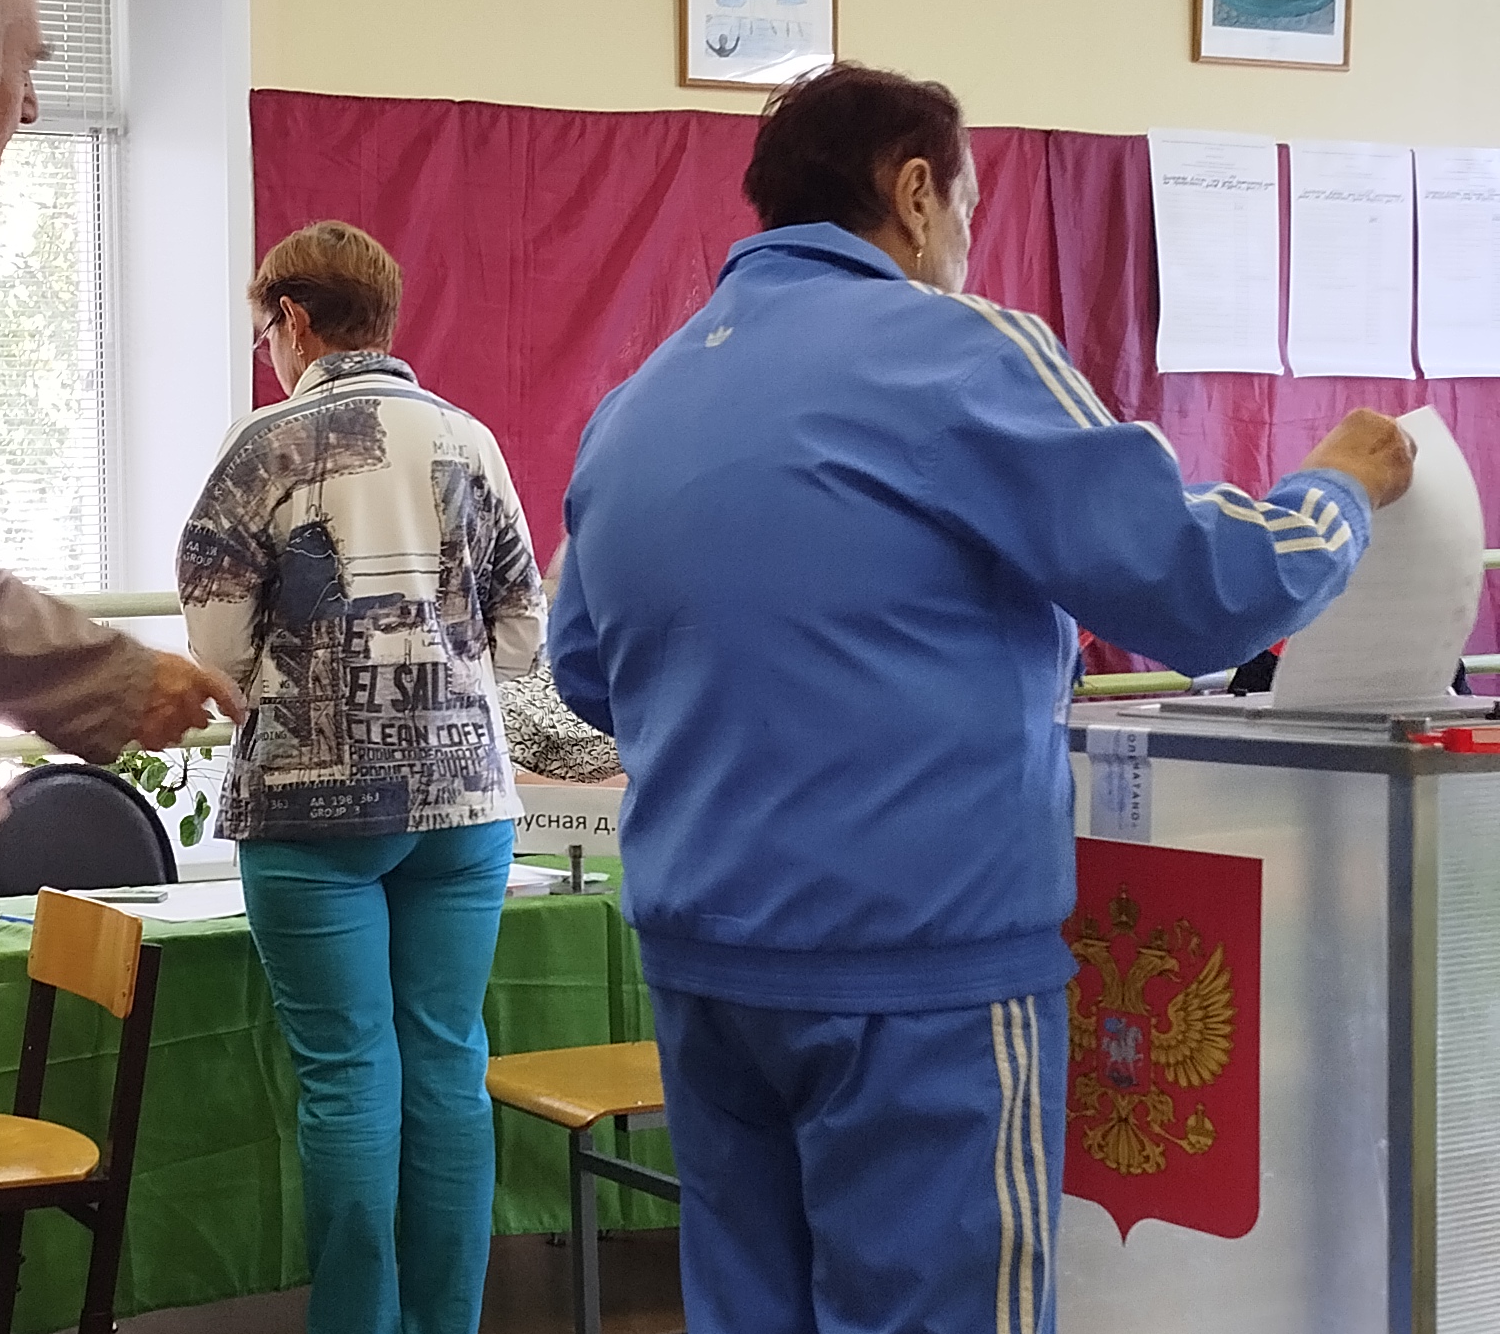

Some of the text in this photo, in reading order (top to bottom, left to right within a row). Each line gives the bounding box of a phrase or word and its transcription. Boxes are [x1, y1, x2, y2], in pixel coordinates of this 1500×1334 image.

[348, 666, 382, 714] EL
[347, 718, 429, 746] CLEAN
[593, 816, 616, 835] д.
